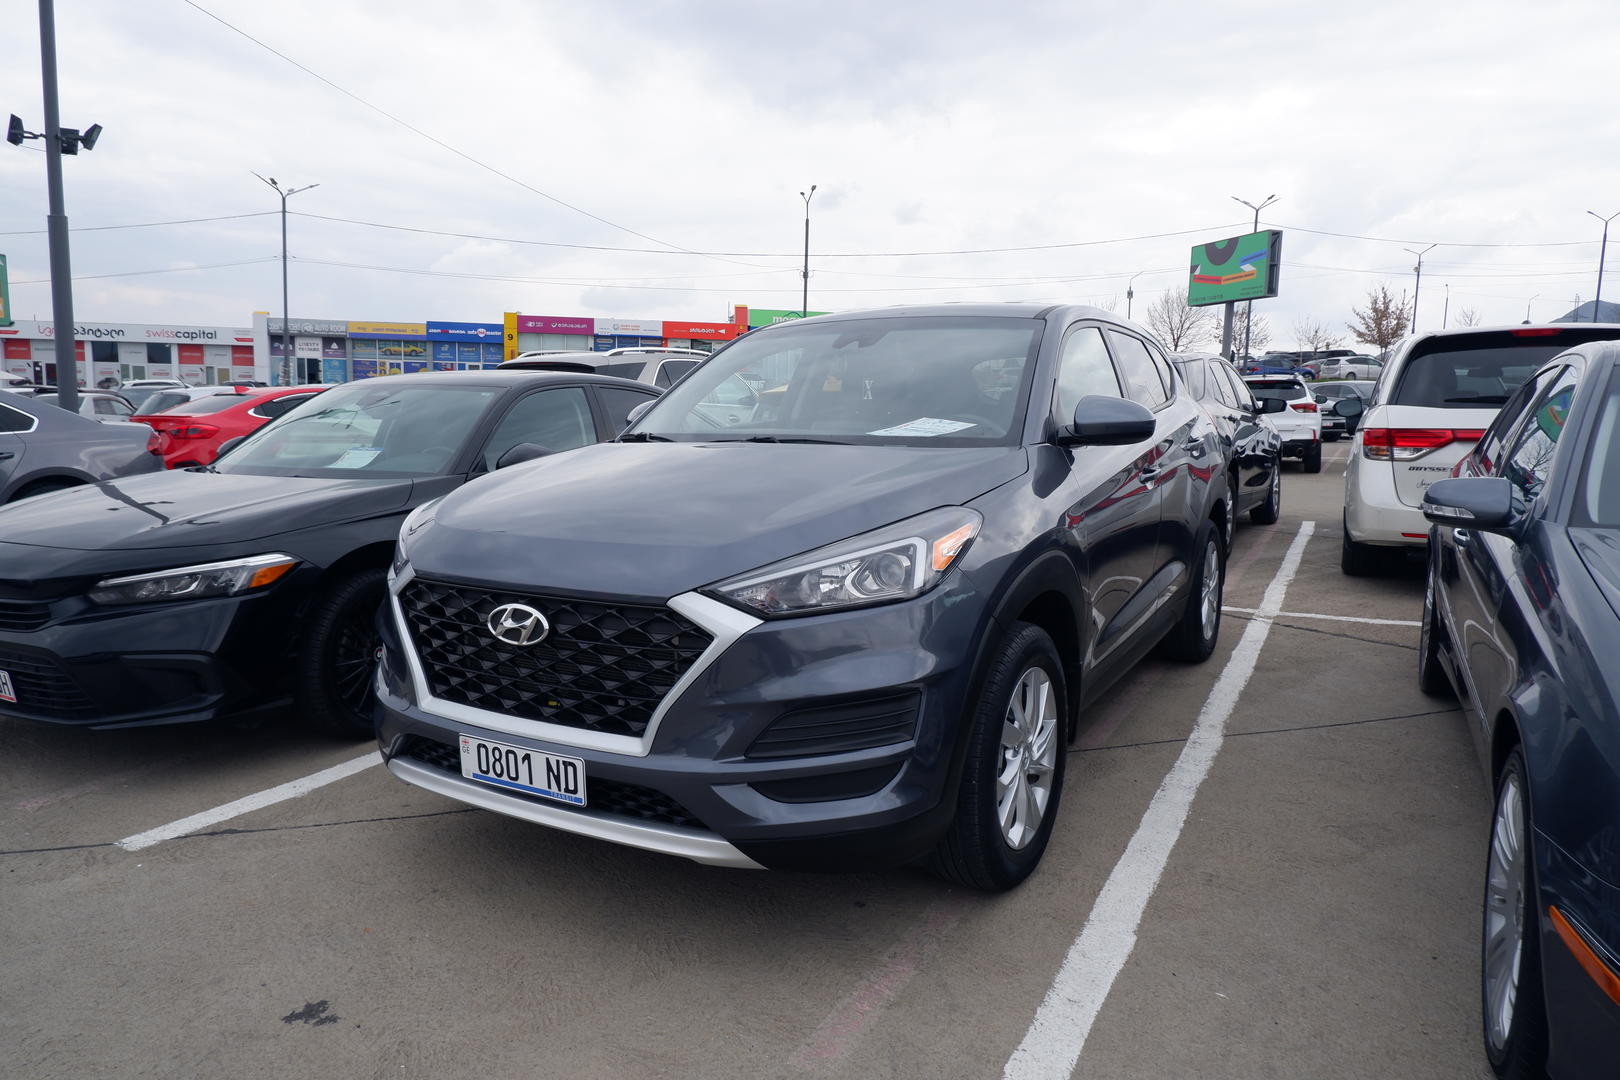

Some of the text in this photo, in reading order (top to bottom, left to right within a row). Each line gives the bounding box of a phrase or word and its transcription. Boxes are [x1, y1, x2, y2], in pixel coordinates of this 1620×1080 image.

[38, 324, 125, 338] სვაპიტალი
[145, 328, 217, 341] swisscapital
[461, 744, 470, 754] GE
[476, 742, 578, 795] 0801 ND
